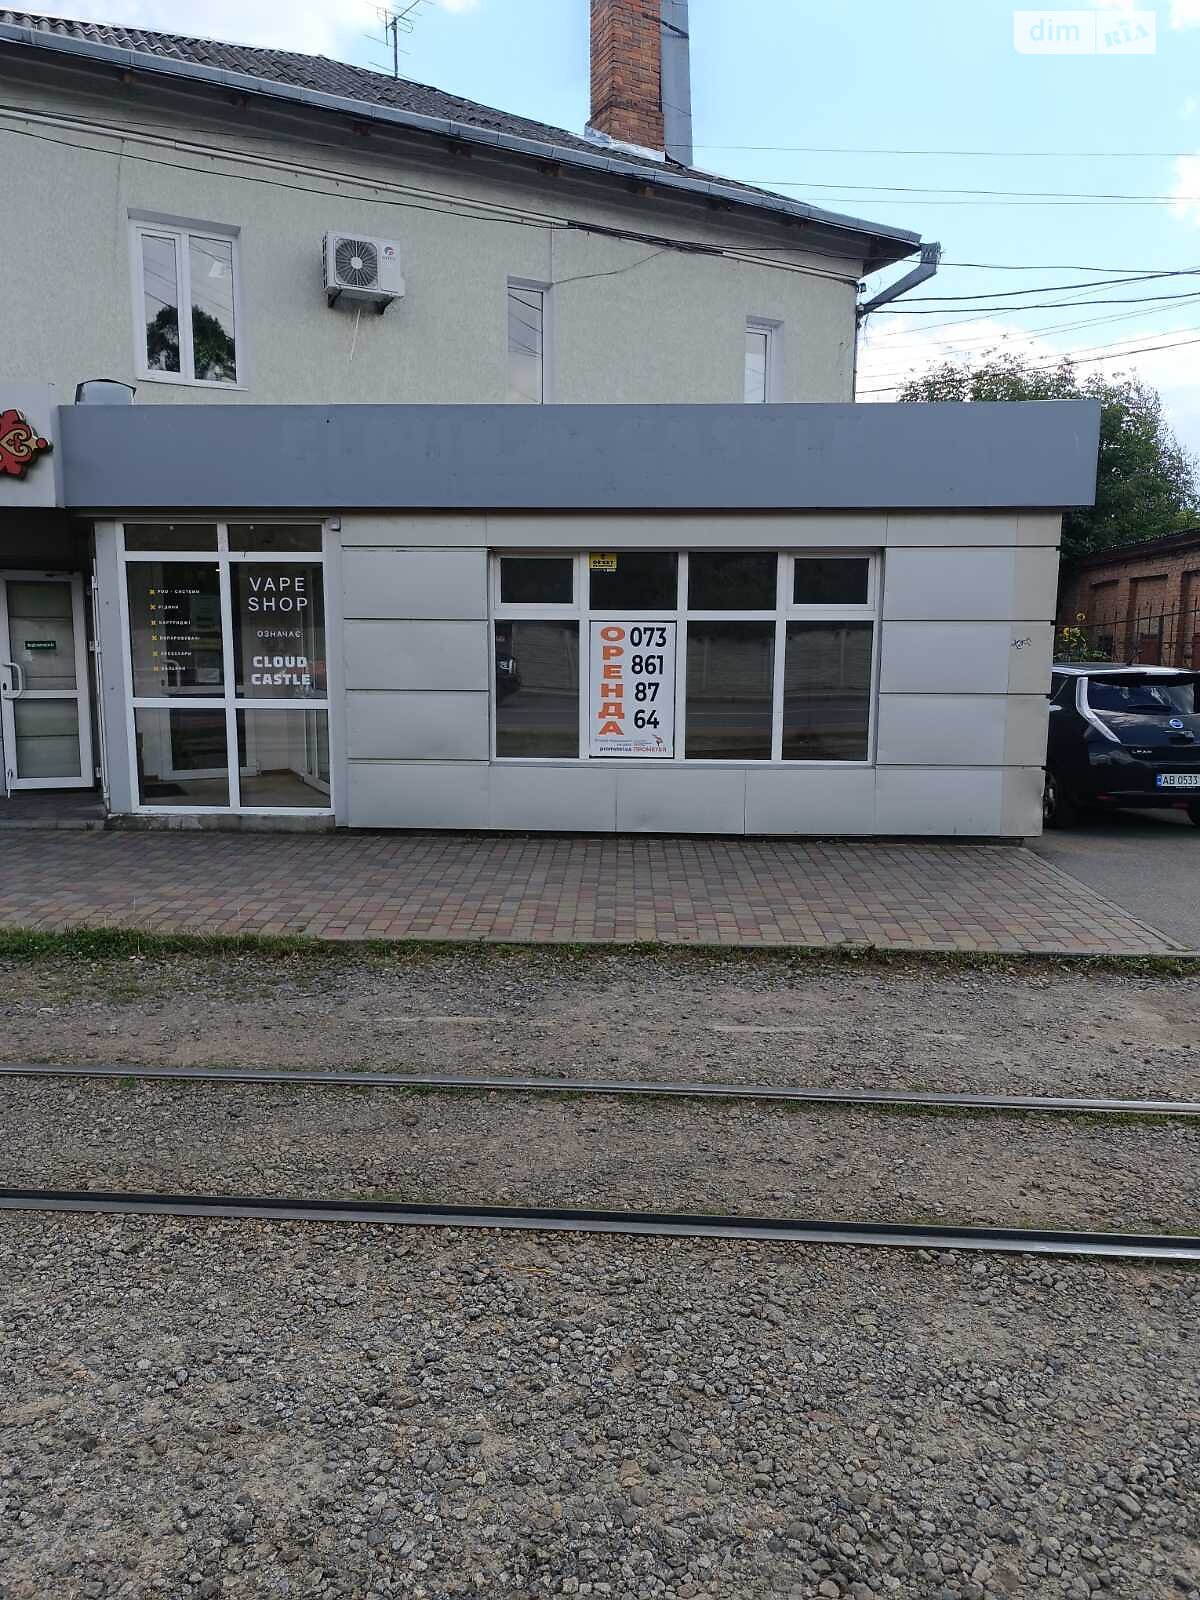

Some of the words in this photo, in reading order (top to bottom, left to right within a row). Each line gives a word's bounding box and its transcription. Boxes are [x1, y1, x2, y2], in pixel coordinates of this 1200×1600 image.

[249, 577, 305, 591] VAPE
[248, 597, 308, 611] SHOP
[630, 626, 667, 647] 073
[252, 656, 308, 668] CLOUD
[631, 654, 664, 675] 861
[251, 674, 311, 685] CASTLE
[598, 626, 625, 736] ОРЕНДА
[634, 682, 660, 702] 87
[633, 709, 660, 729] 64
[1163, 776, 1175, 785] AB
